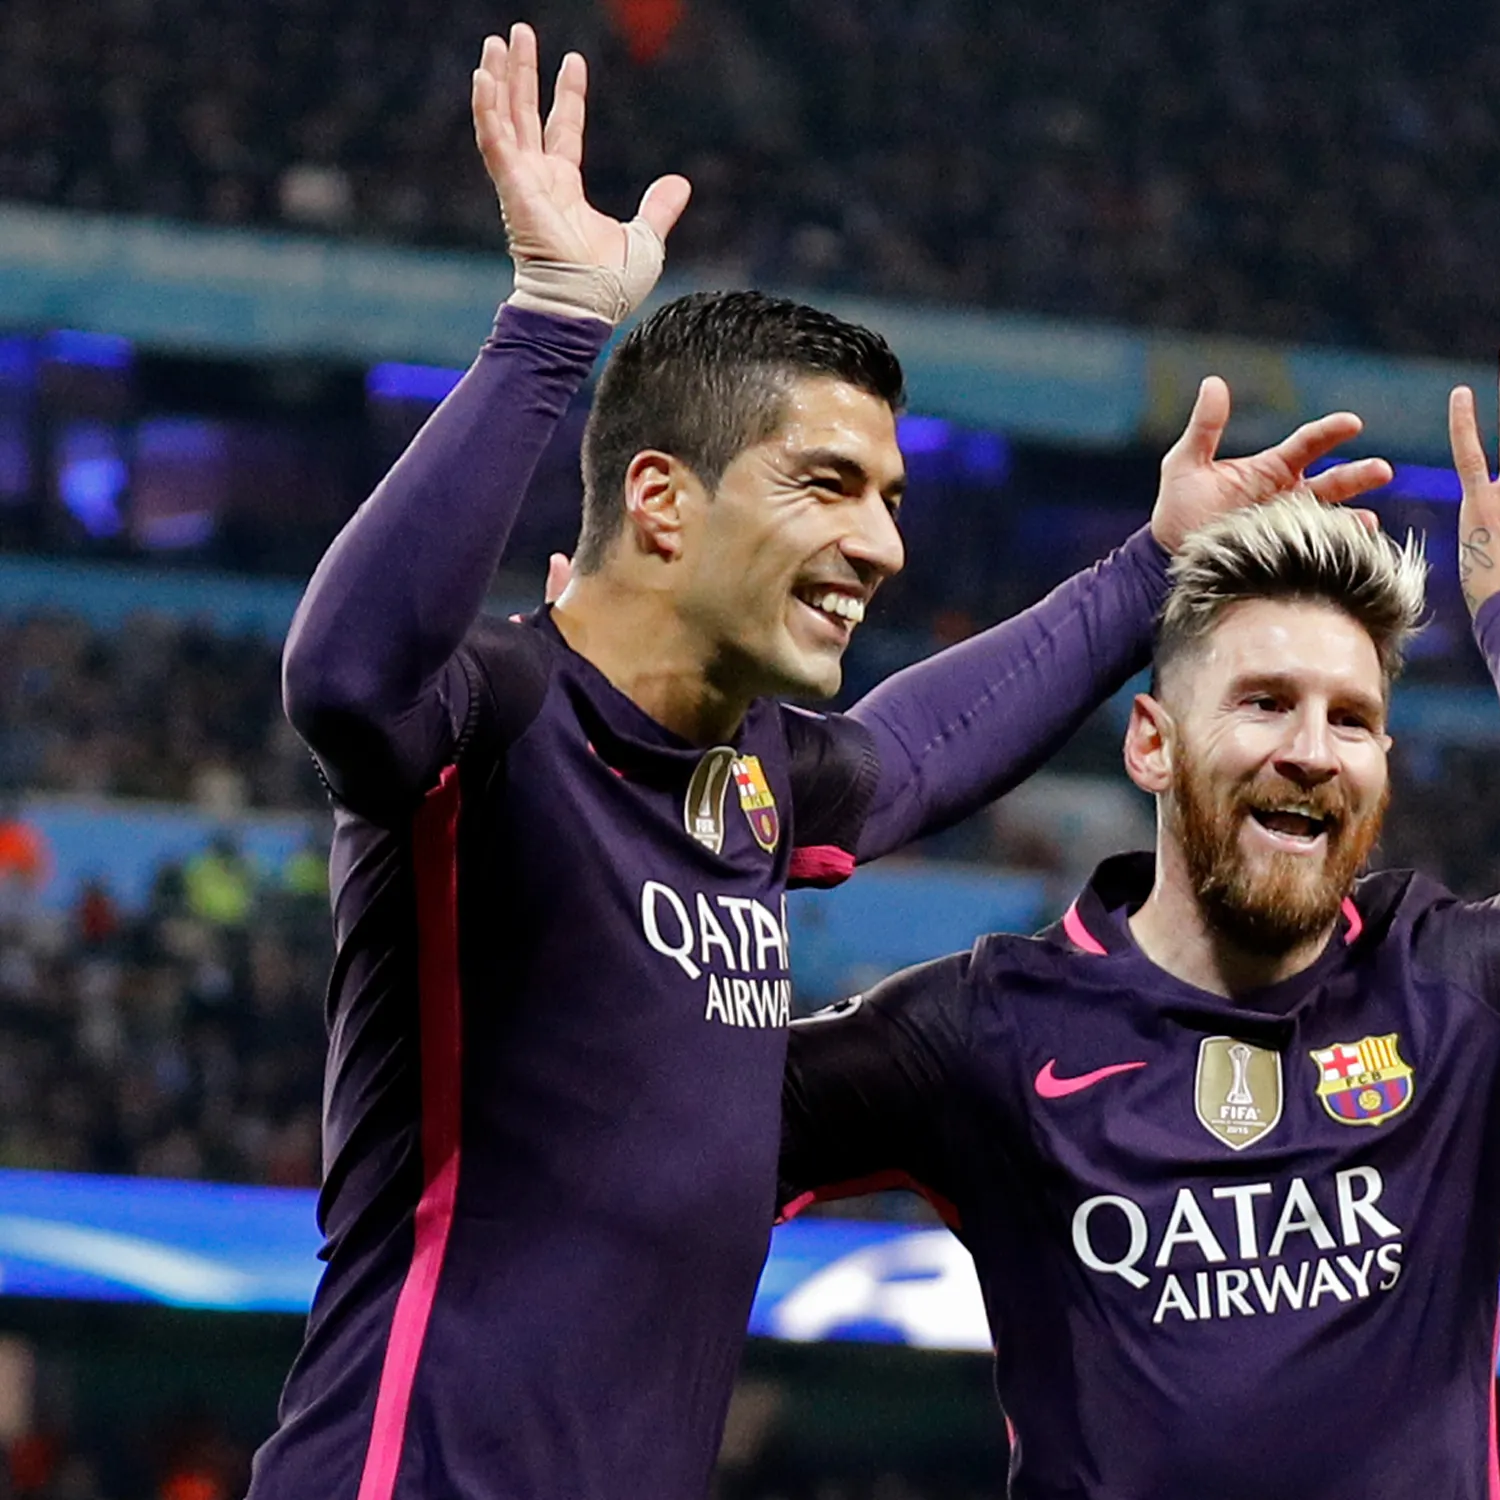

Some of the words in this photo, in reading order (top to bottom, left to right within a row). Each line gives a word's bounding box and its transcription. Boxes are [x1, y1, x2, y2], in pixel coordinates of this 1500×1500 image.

[706, 974, 790, 1028] AIRWA
[1220, 1105, 1259, 1120] FIFA
[1072, 1165, 1402, 1289] QATAR
[1153, 1243, 1403, 1324] AIRWAYS
